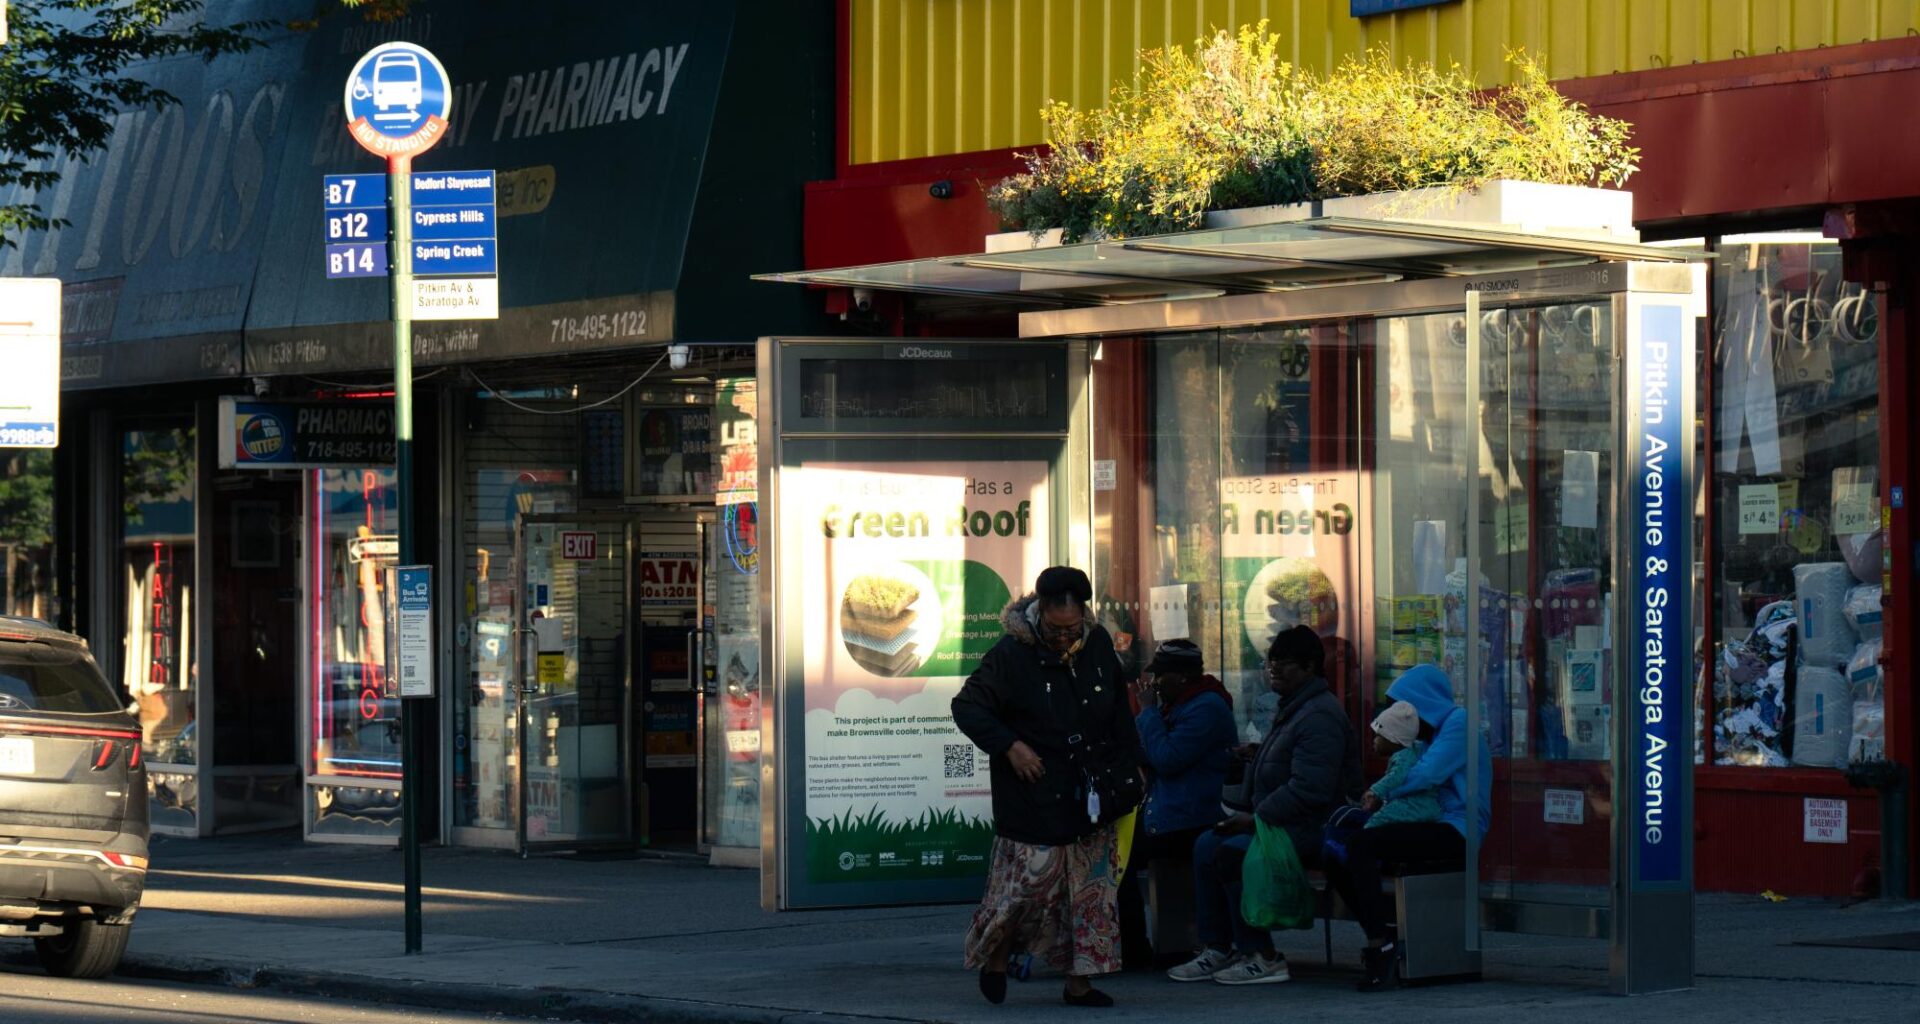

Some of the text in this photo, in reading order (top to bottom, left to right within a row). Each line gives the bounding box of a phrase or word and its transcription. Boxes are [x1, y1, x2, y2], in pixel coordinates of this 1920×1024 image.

[493, 42, 691, 142] PHARMACY
[357, 121, 439, 152] NO STANDING
[414, 176, 491, 191] Bedford Stuyvesant
[329, 179, 356, 204] B7
[415, 210, 485, 226] Cypress Hills
[330, 212, 369, 238] B12
[416, 245, 484, 260] Spring Creek
[330, 247, 375, 274] B14
[418, 282, 474, 293] Pitkin Av &
[1474, 280, 1486, 291] NO
[1486, 278, 1520, 291] SMOKING
[418, 295, 480, 308] Saratoga Av
[551, 310, 647, 343] 718-495-1122
[295, 338, 327, 363] Pitkin
[900, 347, 952, 359] JCDecaux
[965, 478, 997, 495] Has
[1003, 481, 1013, 495] a
[819, 499, 1031, 538] Green Roof
[564, 534, 594, 558] EXIT
[402, 588, 416, 596] Bus
[1640, 341, 1669, 846] Pitkin Avenue & Saratoga Avenue
[402, 595, 428, 603] Arrivals
[979, 612, 1001, 620] Mediu
[980, 630, 1000, 640] Layer
[937, 652, 954, 660] Roof
[834, 715, 955, 727] This project is part of communit
[827, 729, 848, 737] make
[849, 728, 894, 736] Brownsville
[895, 727, 922, 736] cooler,
[923, 726, 958, 736] healthier,
[1809, 799, 1842, 809] AUTOMATIC
[1809, 809, 1842, 818] SPRINKLER
[1809, 818, 1841, 828] BASEMENT
[1817, 828, 1833, 837] ONLY
